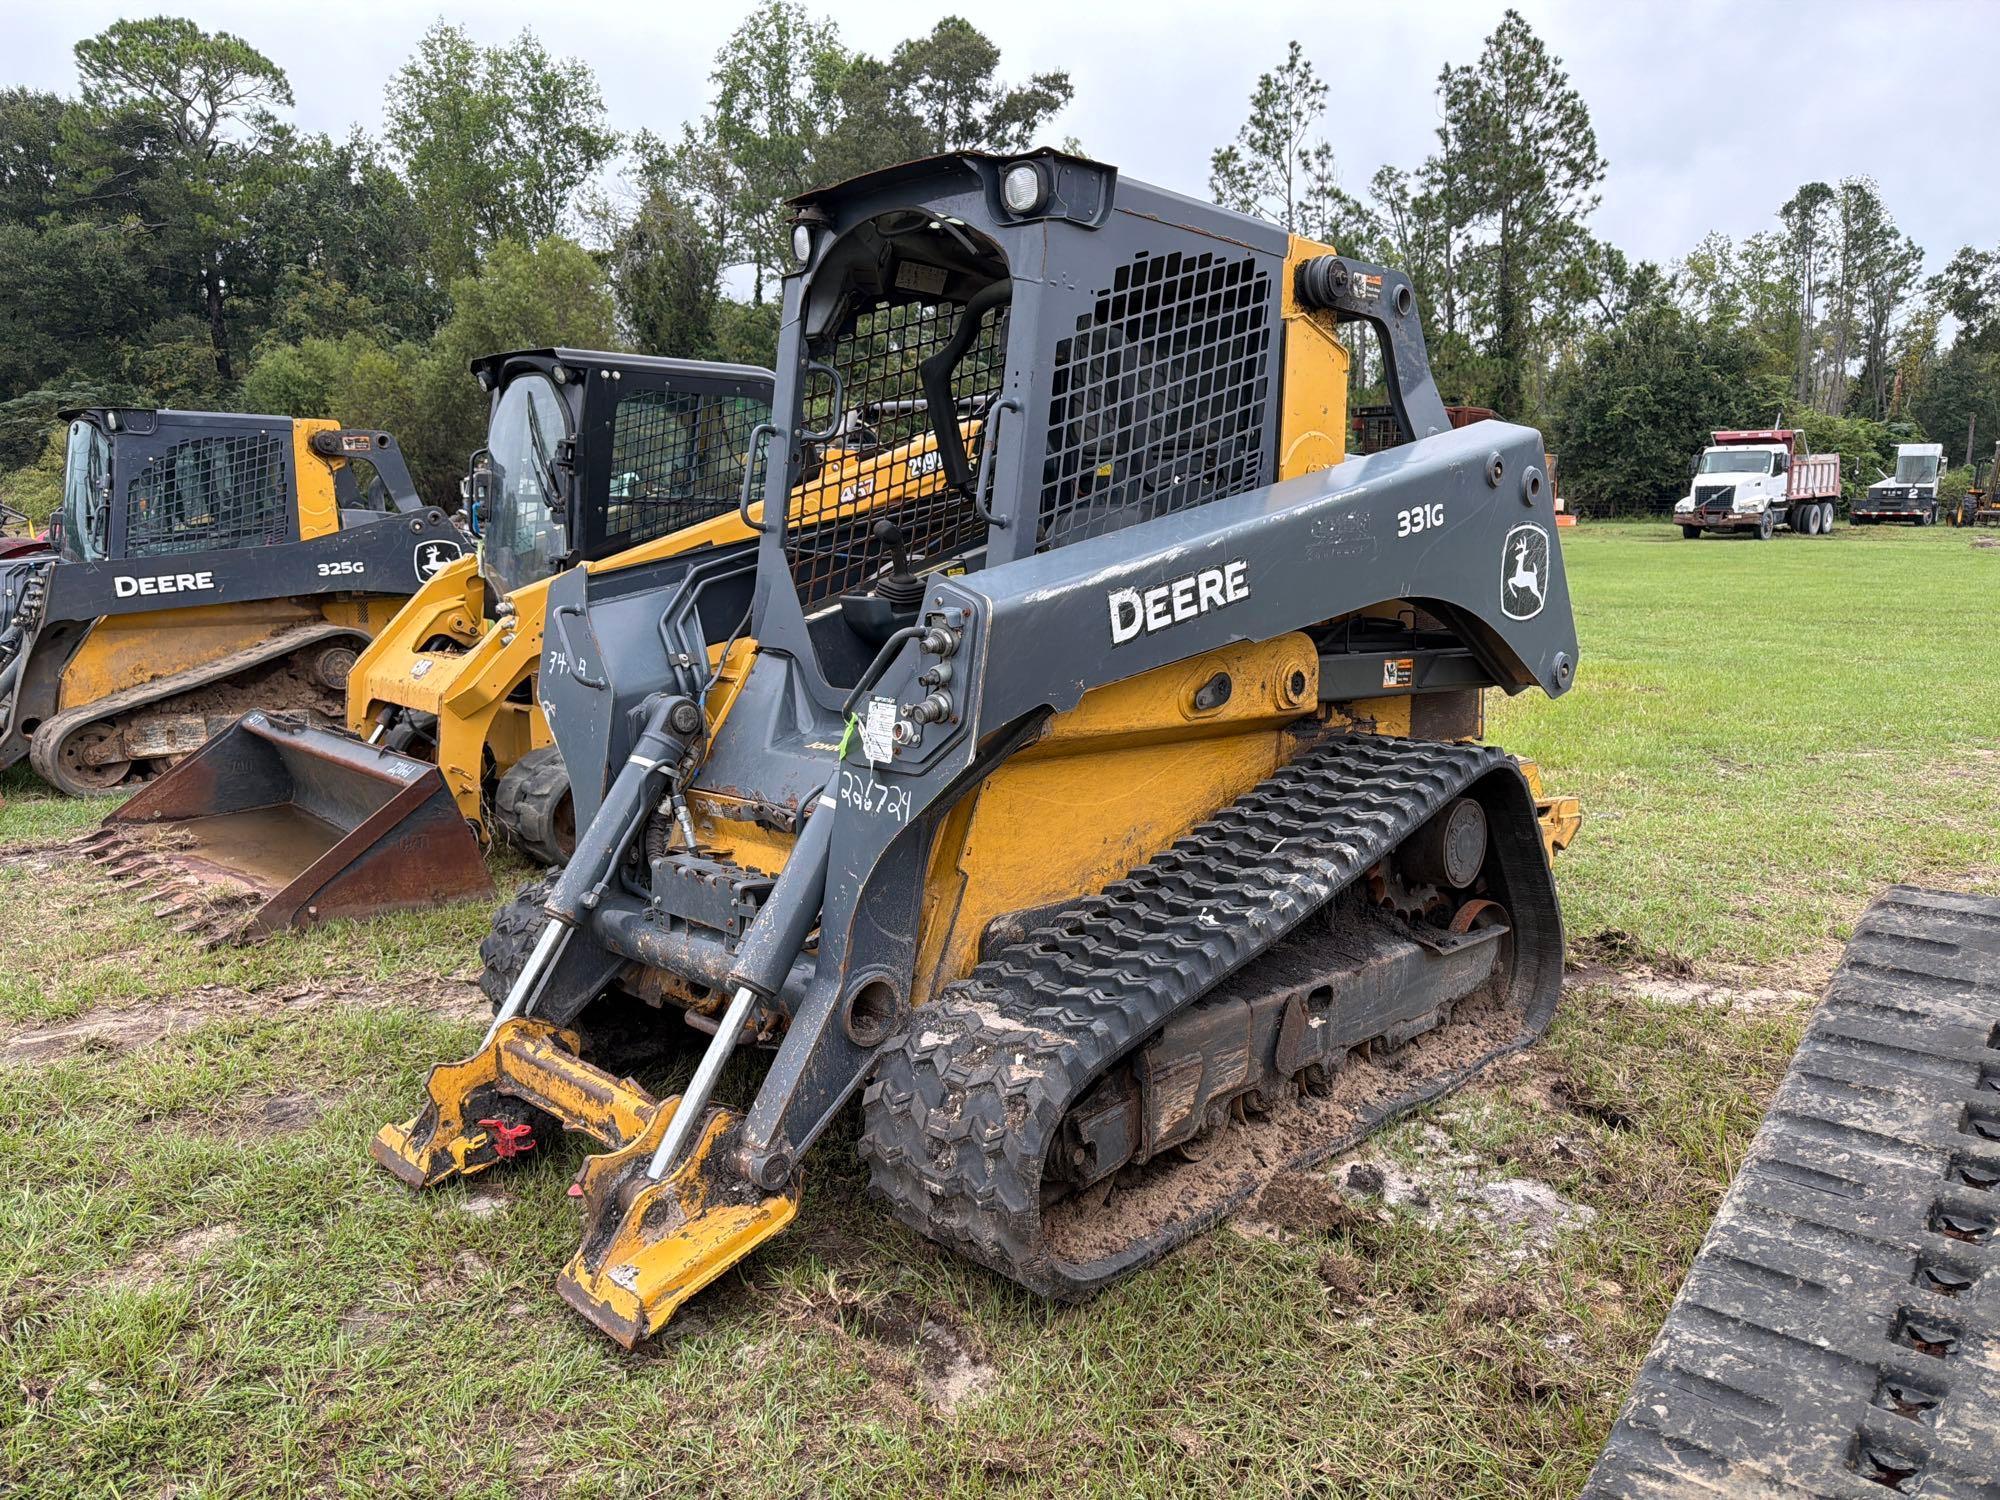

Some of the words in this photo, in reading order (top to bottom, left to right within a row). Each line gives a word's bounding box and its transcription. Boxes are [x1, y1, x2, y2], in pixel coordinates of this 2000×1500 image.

[1908, 488, 1919, 499] 2
[1397, 503, 1444, 538] 331G
[317, 561, 365, 576] 325G
[114, 571, 215, 598] DEERE
[1108, 559, 1250, 644] DEERE
